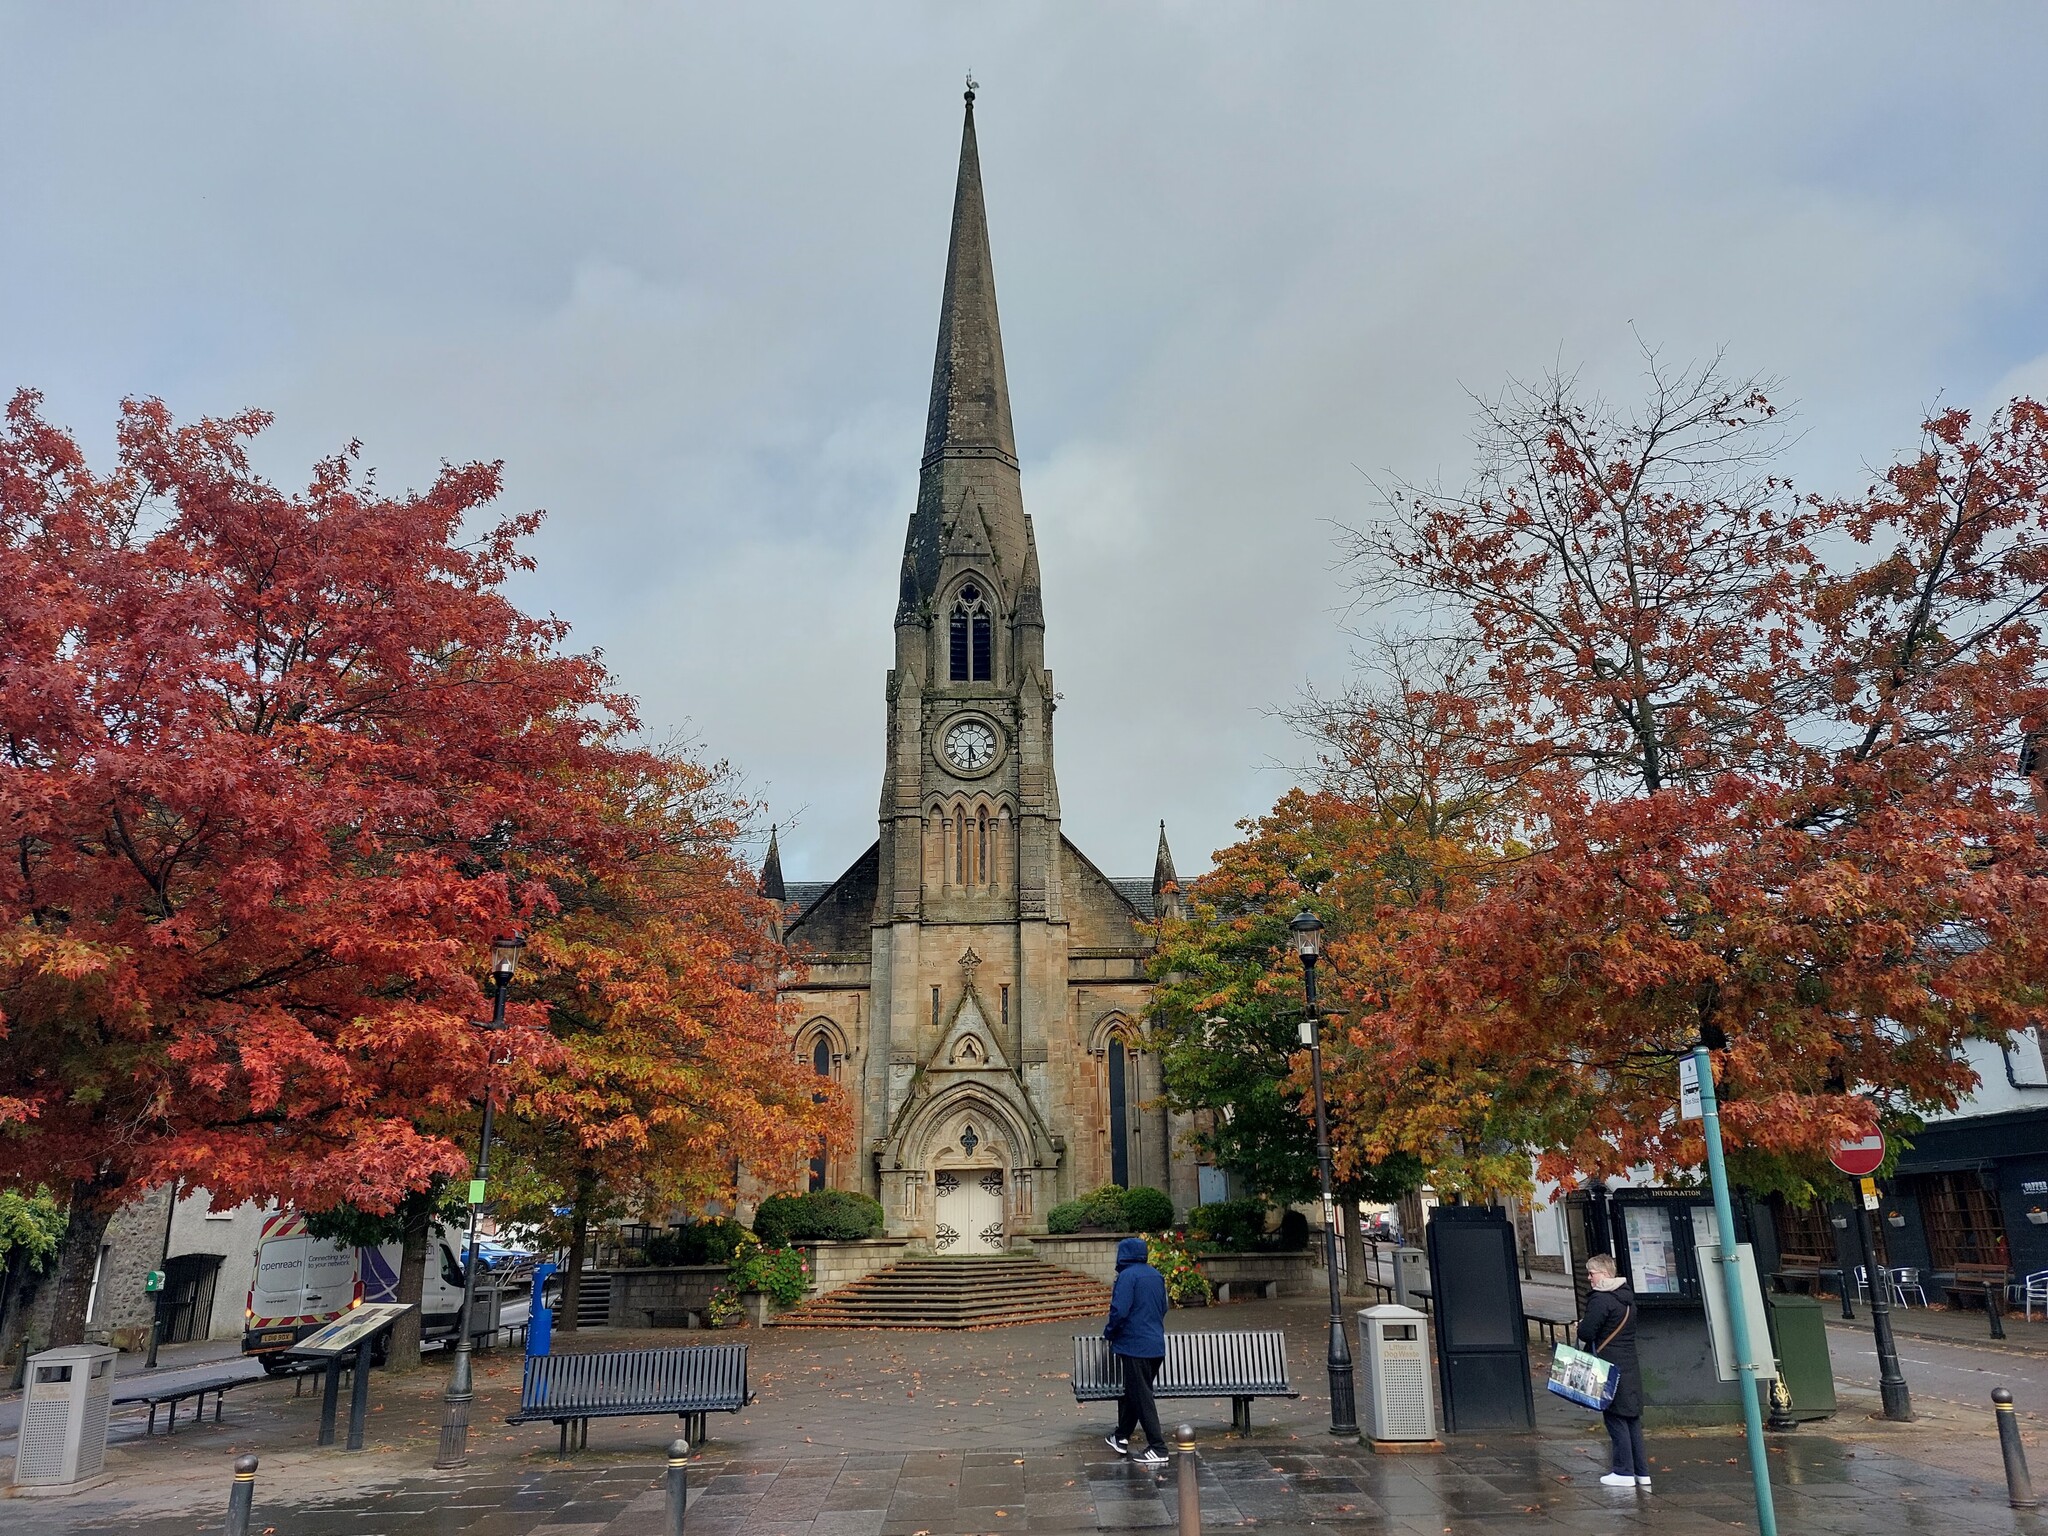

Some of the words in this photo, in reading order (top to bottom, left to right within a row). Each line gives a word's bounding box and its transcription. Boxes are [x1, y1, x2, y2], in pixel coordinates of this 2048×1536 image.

[308, 1254, 338, 1262] Connecting
[261, 1259, 302, 1272] openreach
[314, 1262, 327, 1270] your
[1384, 1351, 1397, 1359] Dog
